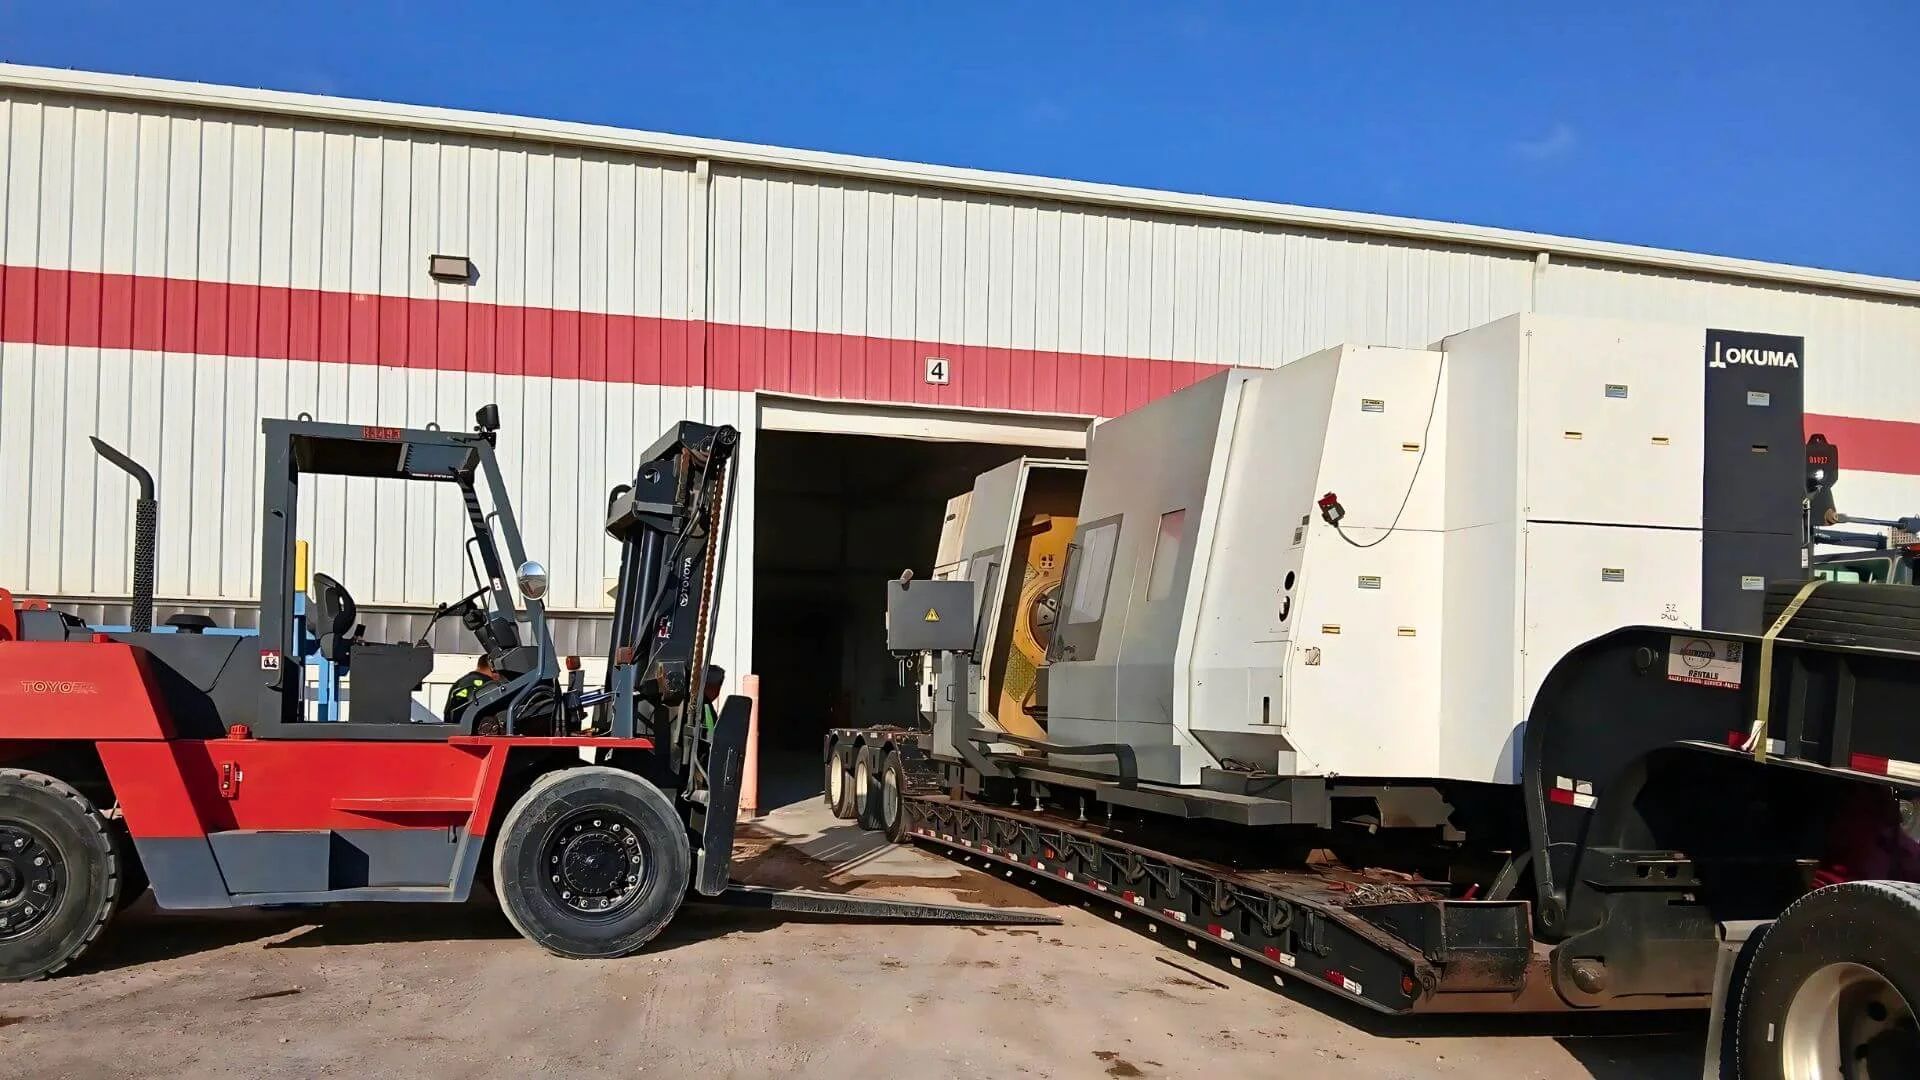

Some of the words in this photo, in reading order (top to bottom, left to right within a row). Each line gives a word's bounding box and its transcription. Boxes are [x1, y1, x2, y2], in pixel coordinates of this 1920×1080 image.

[1726, 348, 1799, 368] OKUMA
[931, 361, 944, 380] 4
[681, 557, 692, 593] TOYOTA
[1688, 669, 1719, 679] RENTALS
